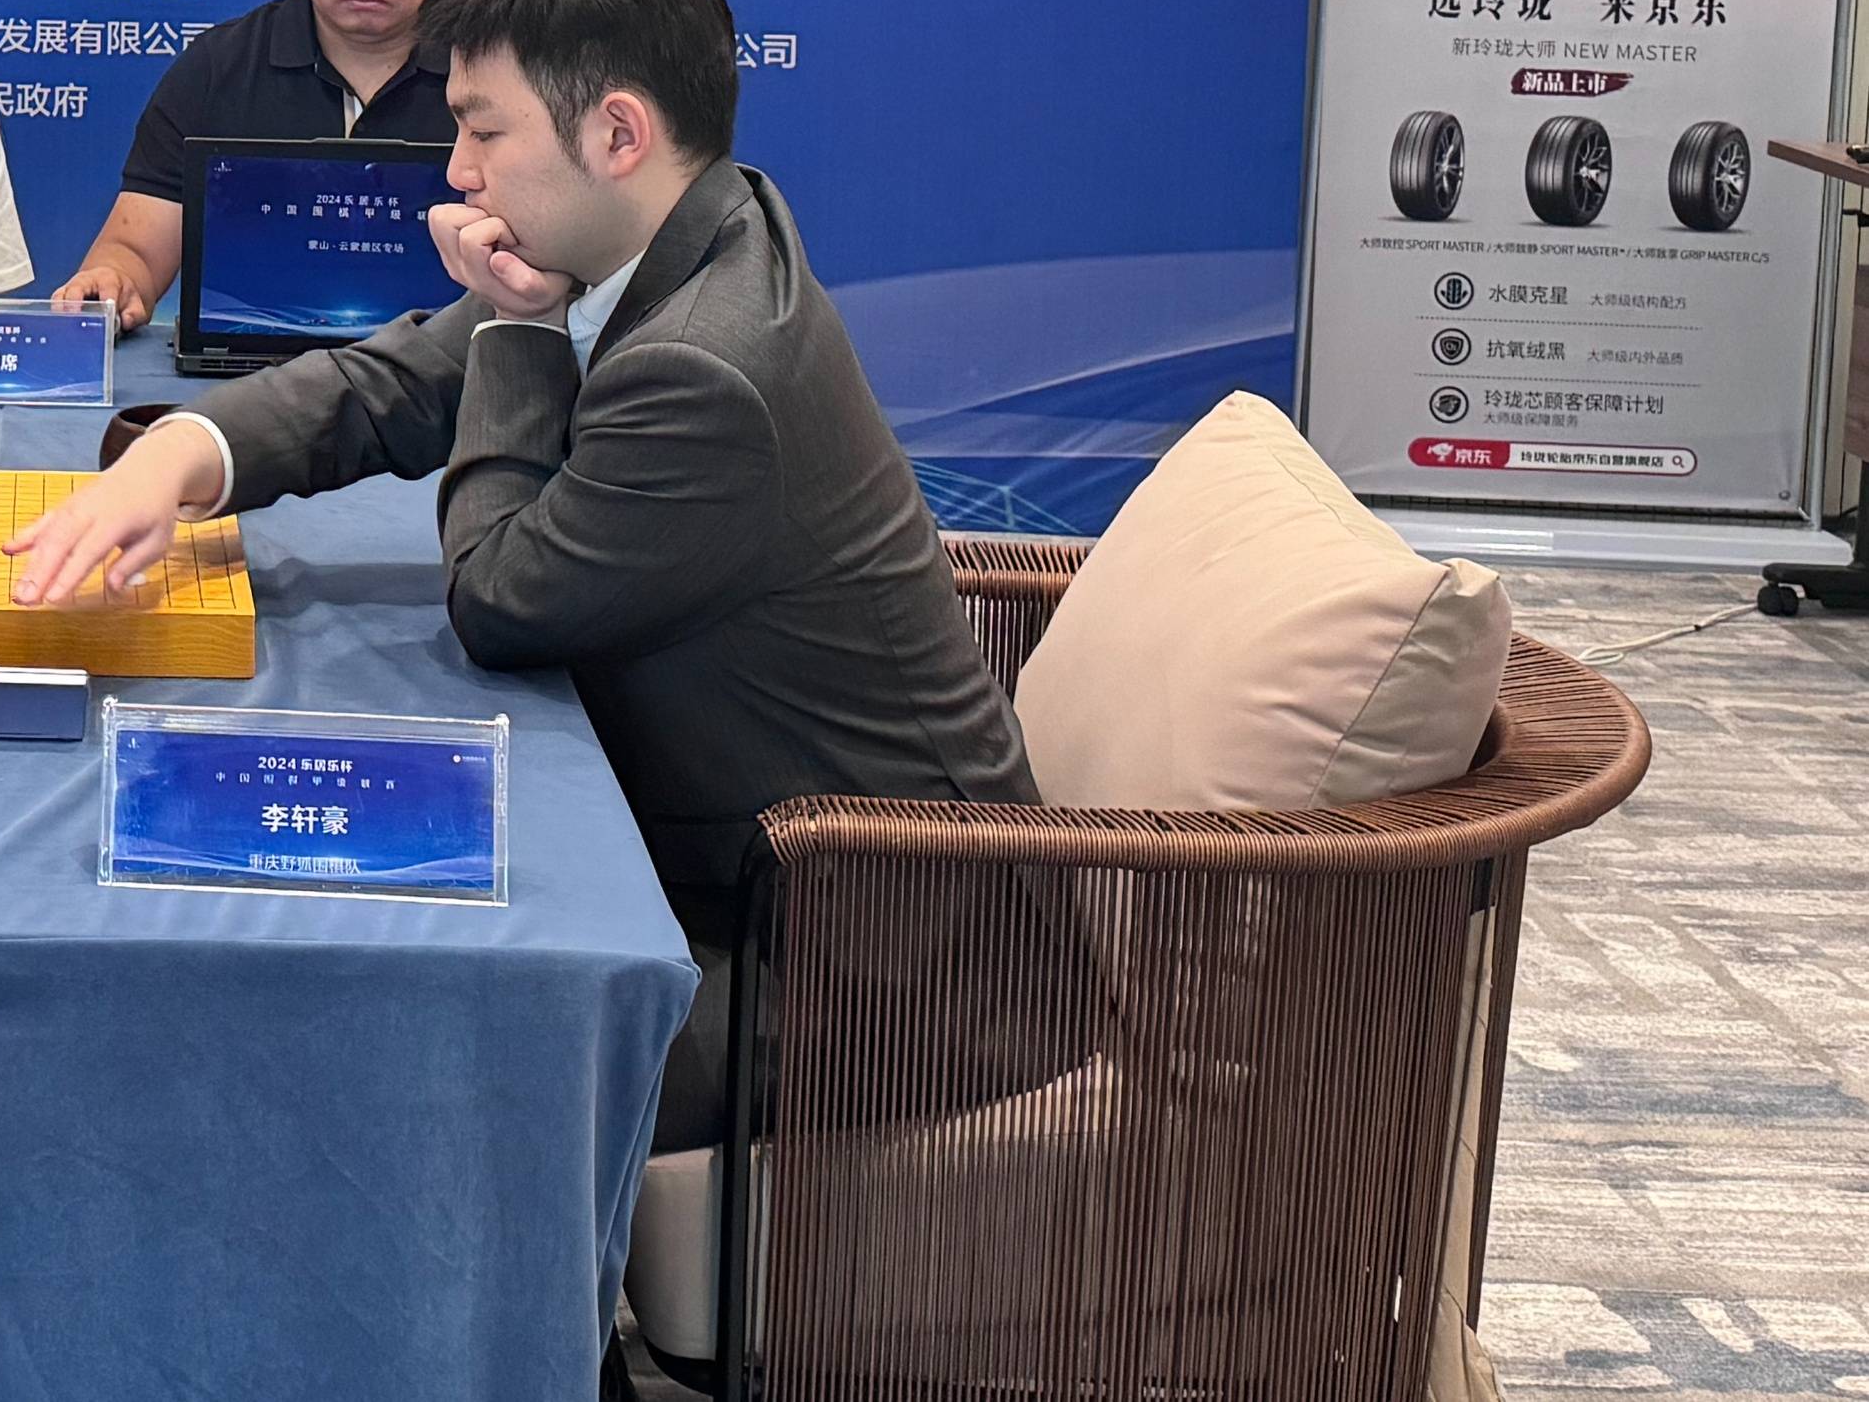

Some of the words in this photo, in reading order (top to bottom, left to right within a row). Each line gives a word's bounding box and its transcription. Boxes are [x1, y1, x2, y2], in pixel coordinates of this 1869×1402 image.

[1452, 36, 1557, 59] 新玲珑大师
[1563, 42, 1609, 59] NEW
[1616, 44, 1698, 62] MASTER
[316, 194, 341, 204] 2024
[1442, 241, 1484, 253] MASTER
[1707, 250, 1751, 262] MASTER
[1489, 284, 1568, 305] 水膜克星
[1487, 339, 1566, 361] 抗氧绒黑
[1455, 448, 1492, 465] 京东
[258, 756, 296, 770] 2024
[261, 803, 349, 835] 李轩豪
